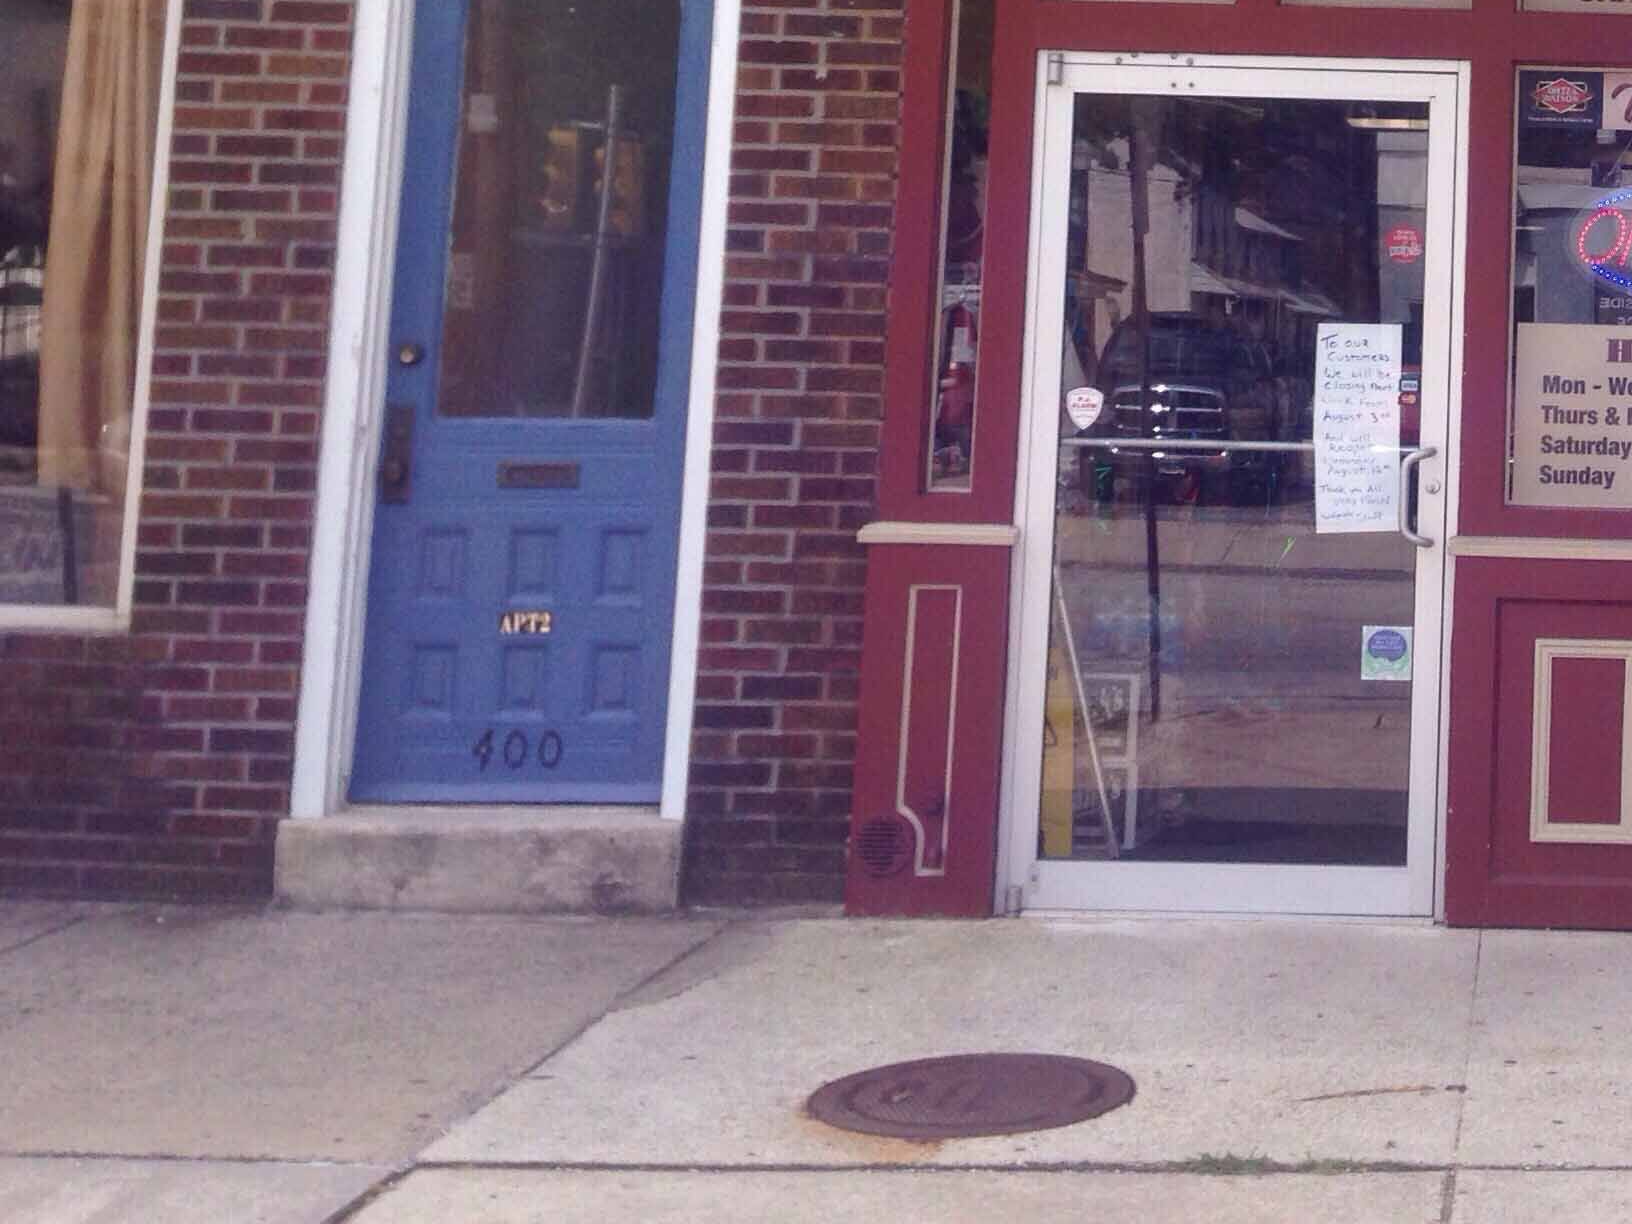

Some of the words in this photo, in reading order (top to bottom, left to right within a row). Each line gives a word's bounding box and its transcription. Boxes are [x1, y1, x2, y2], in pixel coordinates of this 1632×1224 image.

[1542, 375, 1589, 396] Mon
[1541, 405, 1598, 426] Thurs
[1605, 407, 1620, 427] &
[1540, 435, 1632, 460] Saturday
[1539, 465, 1615, 489] Sunday
[472, 728, 563, 772] 400
